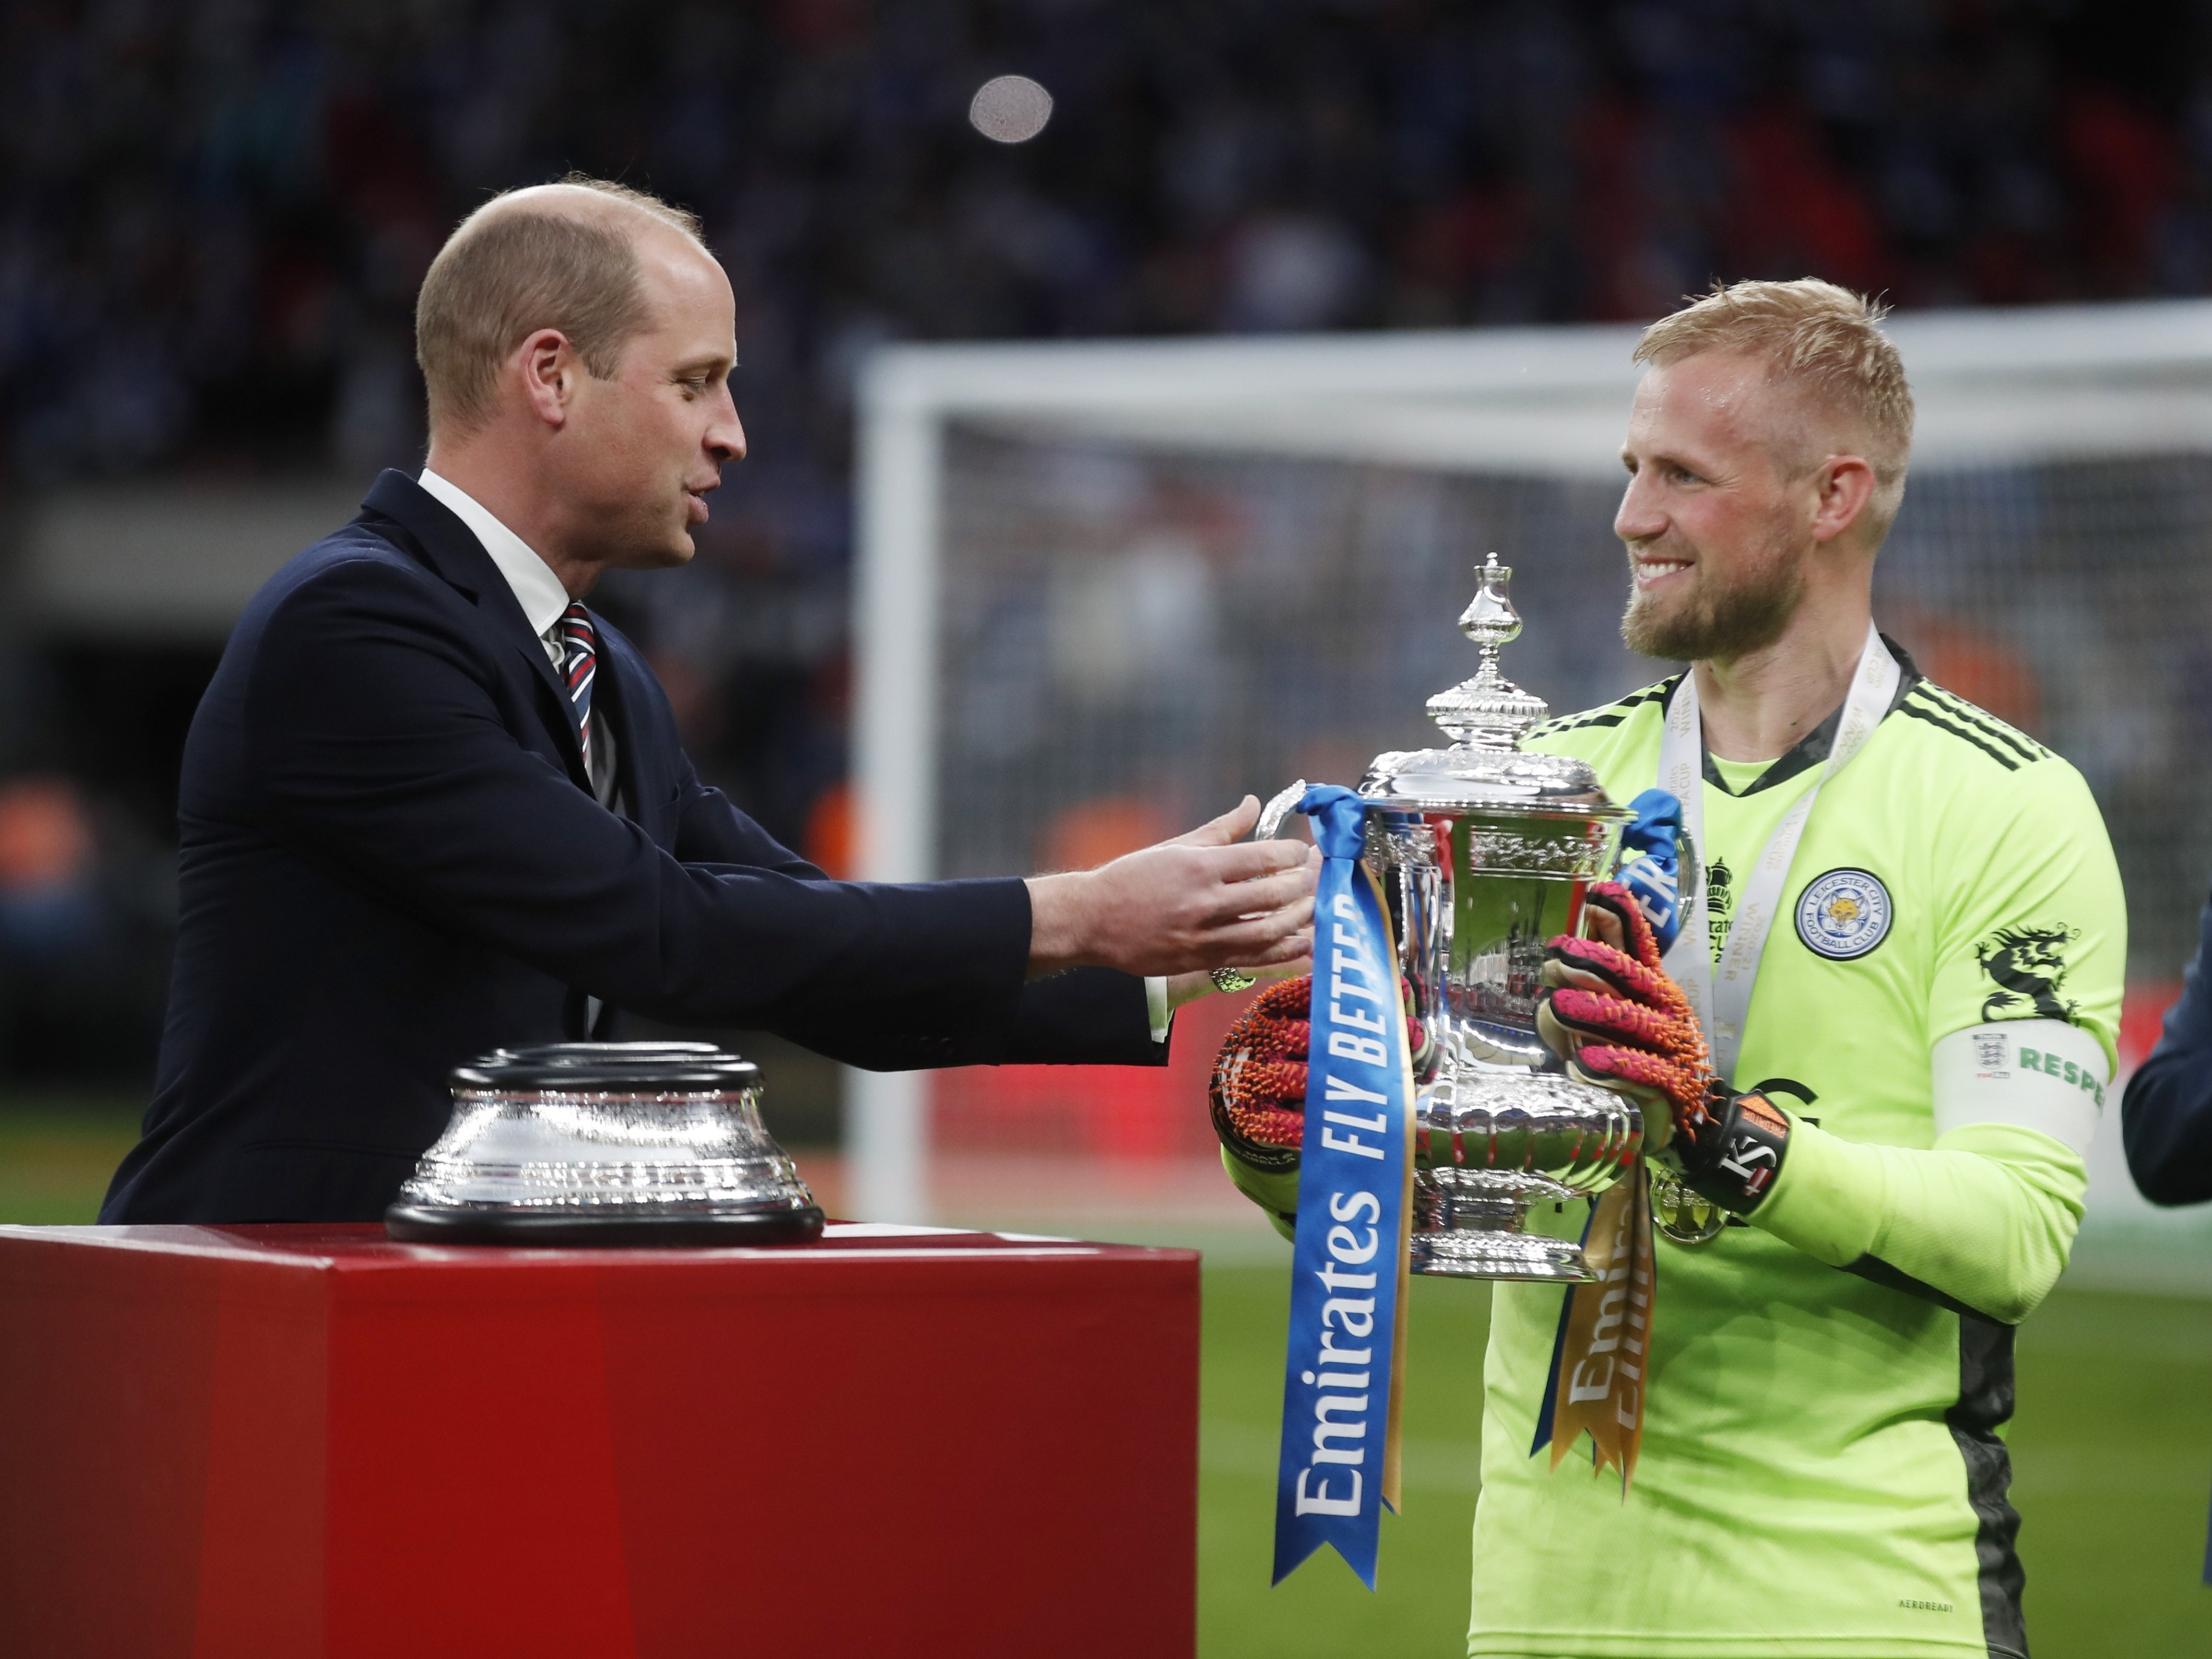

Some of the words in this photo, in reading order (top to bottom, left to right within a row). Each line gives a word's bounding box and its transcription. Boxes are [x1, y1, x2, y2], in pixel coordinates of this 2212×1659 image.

[1622, 857, 1678, 928] ER
[1810, 877, 1870, 906] LEICESTER
[1869, 889, 1883, 915] CITY
[1725, 903, 1760, 981] WINNER
[1806, 912, 1852, 949] FOOTBALL
[1853, 921, 1880, 946] CLUB
[1321, 1074, 1388, 1161] FLY
[1295, 1190, 1381, 1518] Emirates
